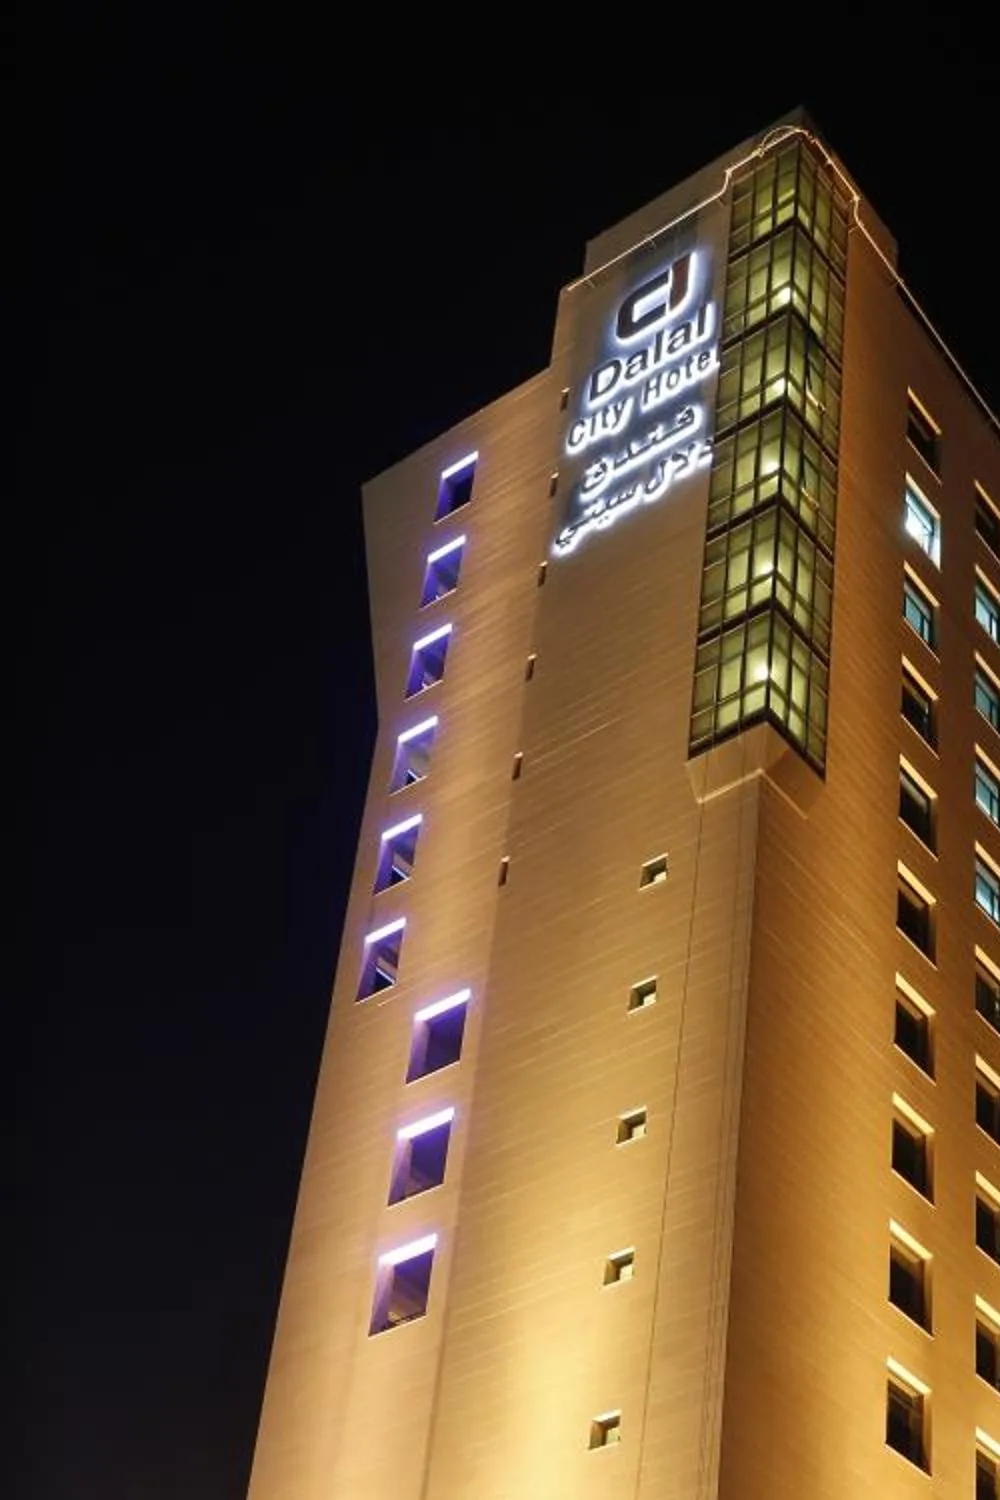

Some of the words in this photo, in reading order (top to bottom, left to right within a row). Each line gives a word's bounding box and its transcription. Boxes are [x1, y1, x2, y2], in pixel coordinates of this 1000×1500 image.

[588, 303, 708, 402] Dalal
[567, 399, 630, 449] City
[642, 345, 719, 405] Hotel
[580, 407, 696, 493] فندق
[645, 439, 713, 494] دلال
[555, 486, 637, 547] سيتي
